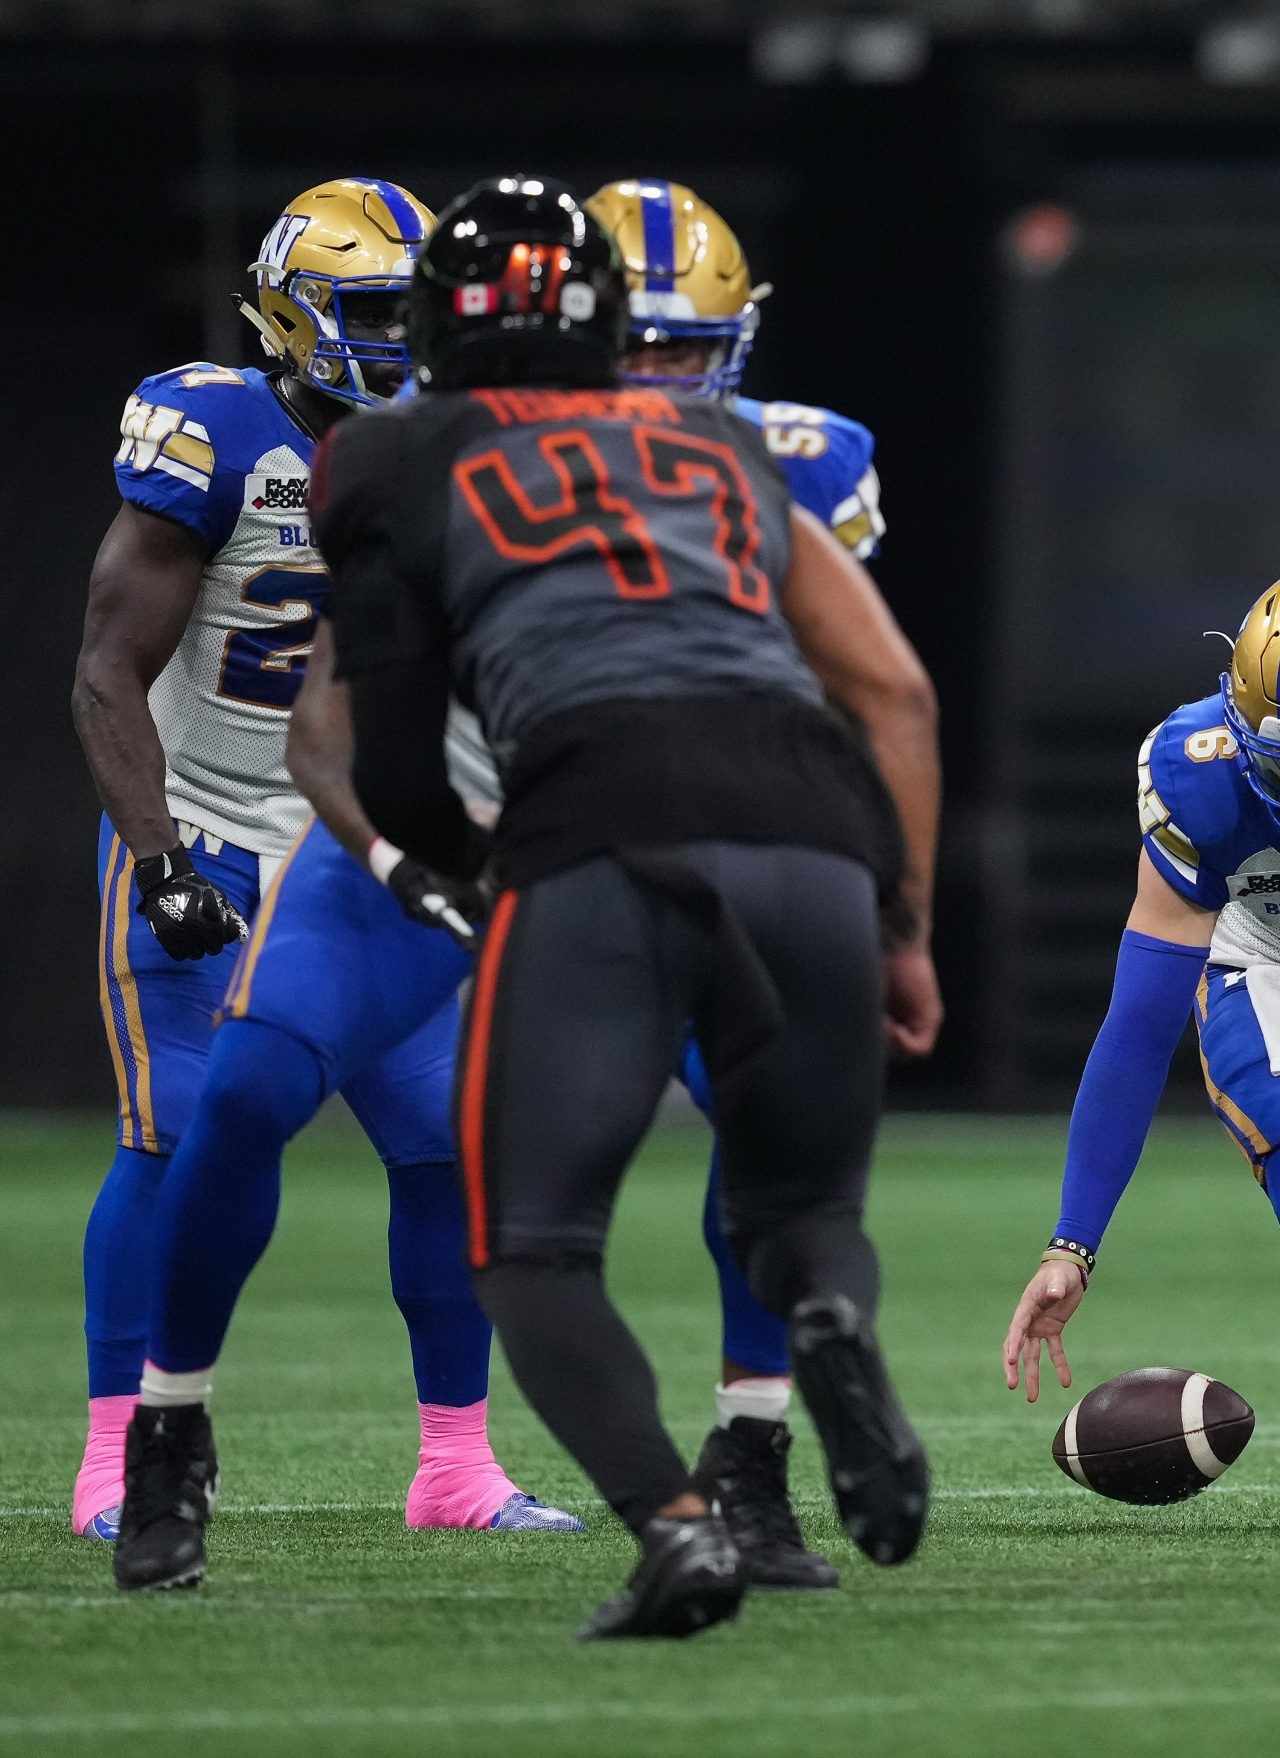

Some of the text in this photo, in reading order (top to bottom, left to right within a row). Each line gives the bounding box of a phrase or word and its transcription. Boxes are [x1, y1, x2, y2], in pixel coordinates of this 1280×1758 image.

[265, 478, 309, 488] PLAY
[265, 488, 309, 498] NOW
[452, 426, 771, 615] 47
[279, 526, 319, 548] BLU
[1184, 725, 1240, 763] 6
